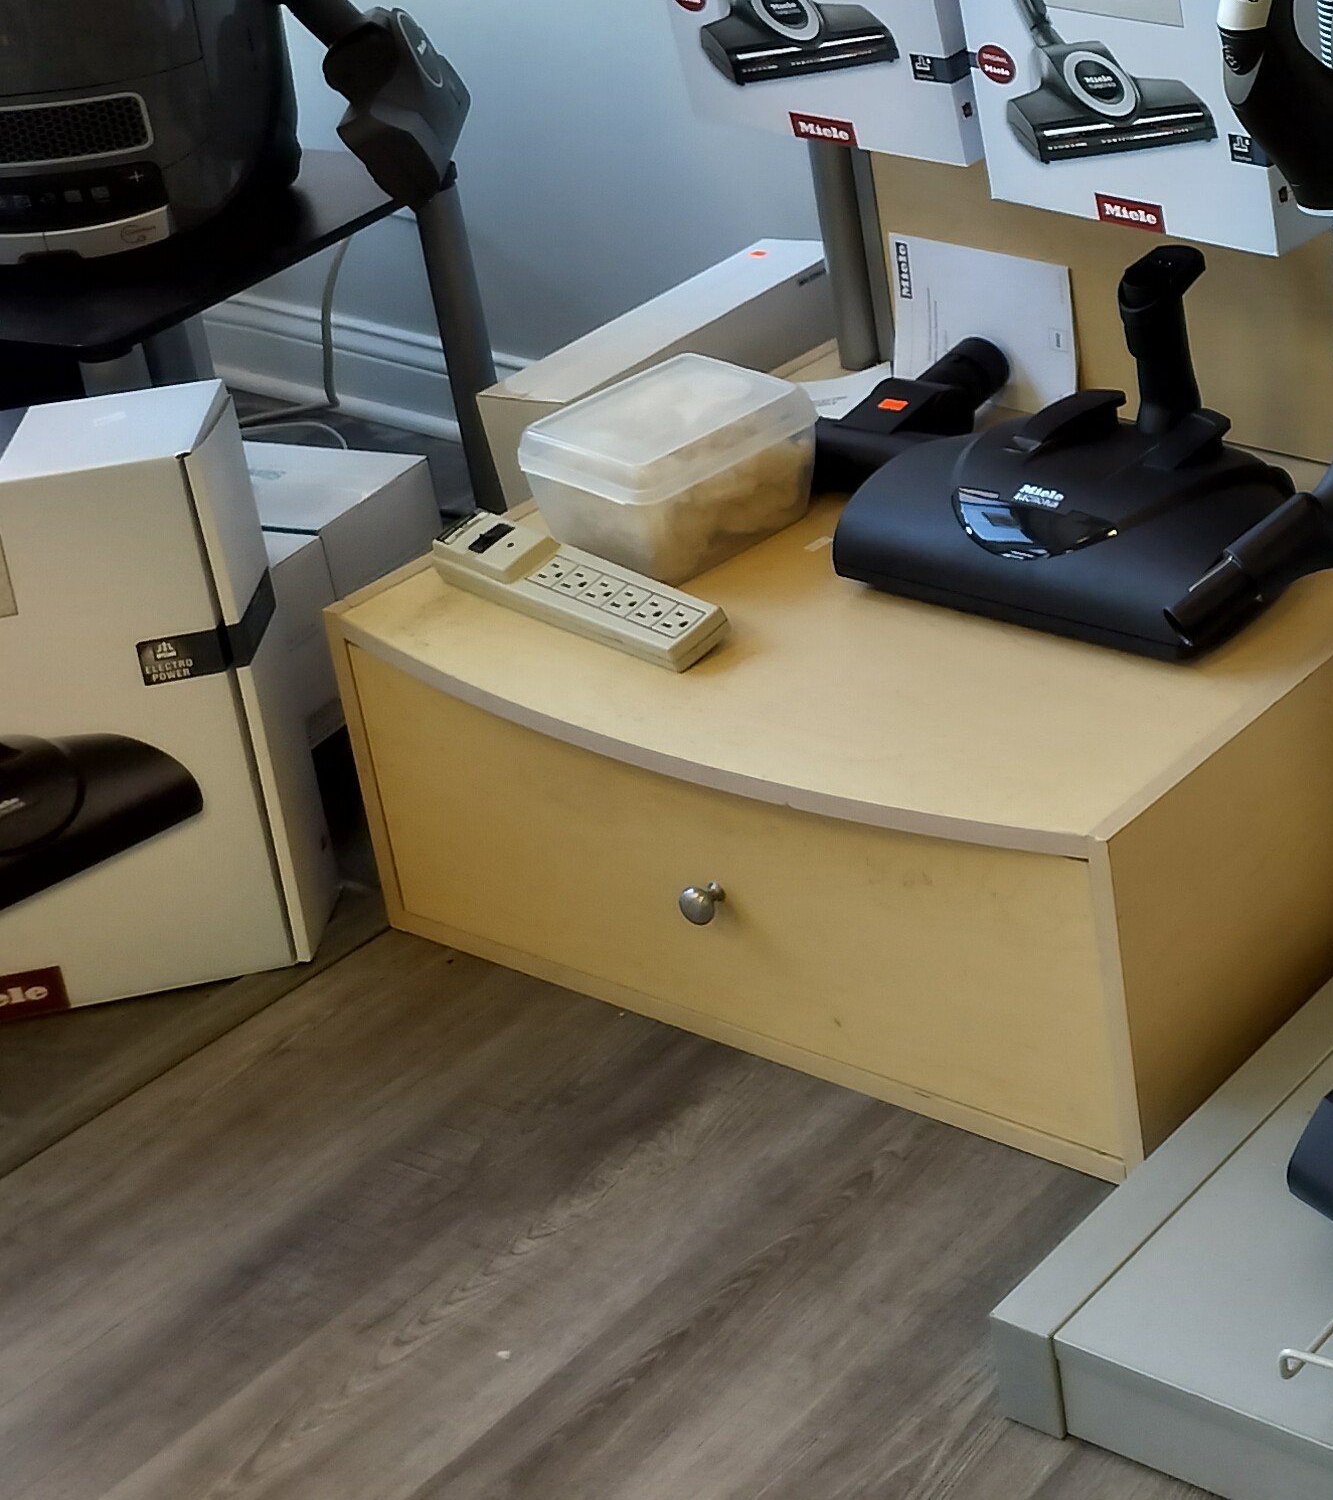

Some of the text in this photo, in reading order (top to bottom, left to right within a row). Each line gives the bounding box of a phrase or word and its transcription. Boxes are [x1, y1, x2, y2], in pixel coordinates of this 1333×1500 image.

[798, 121, 849, 141] Miele
[1103, 203, 1157, 225] Miele
[1019, 484, 1064, 501] Miele
[145, 658, 194, 675] ELECTRO
[152, 669, 191, 682] POWER
[0, 984, 48, 1005] ele
